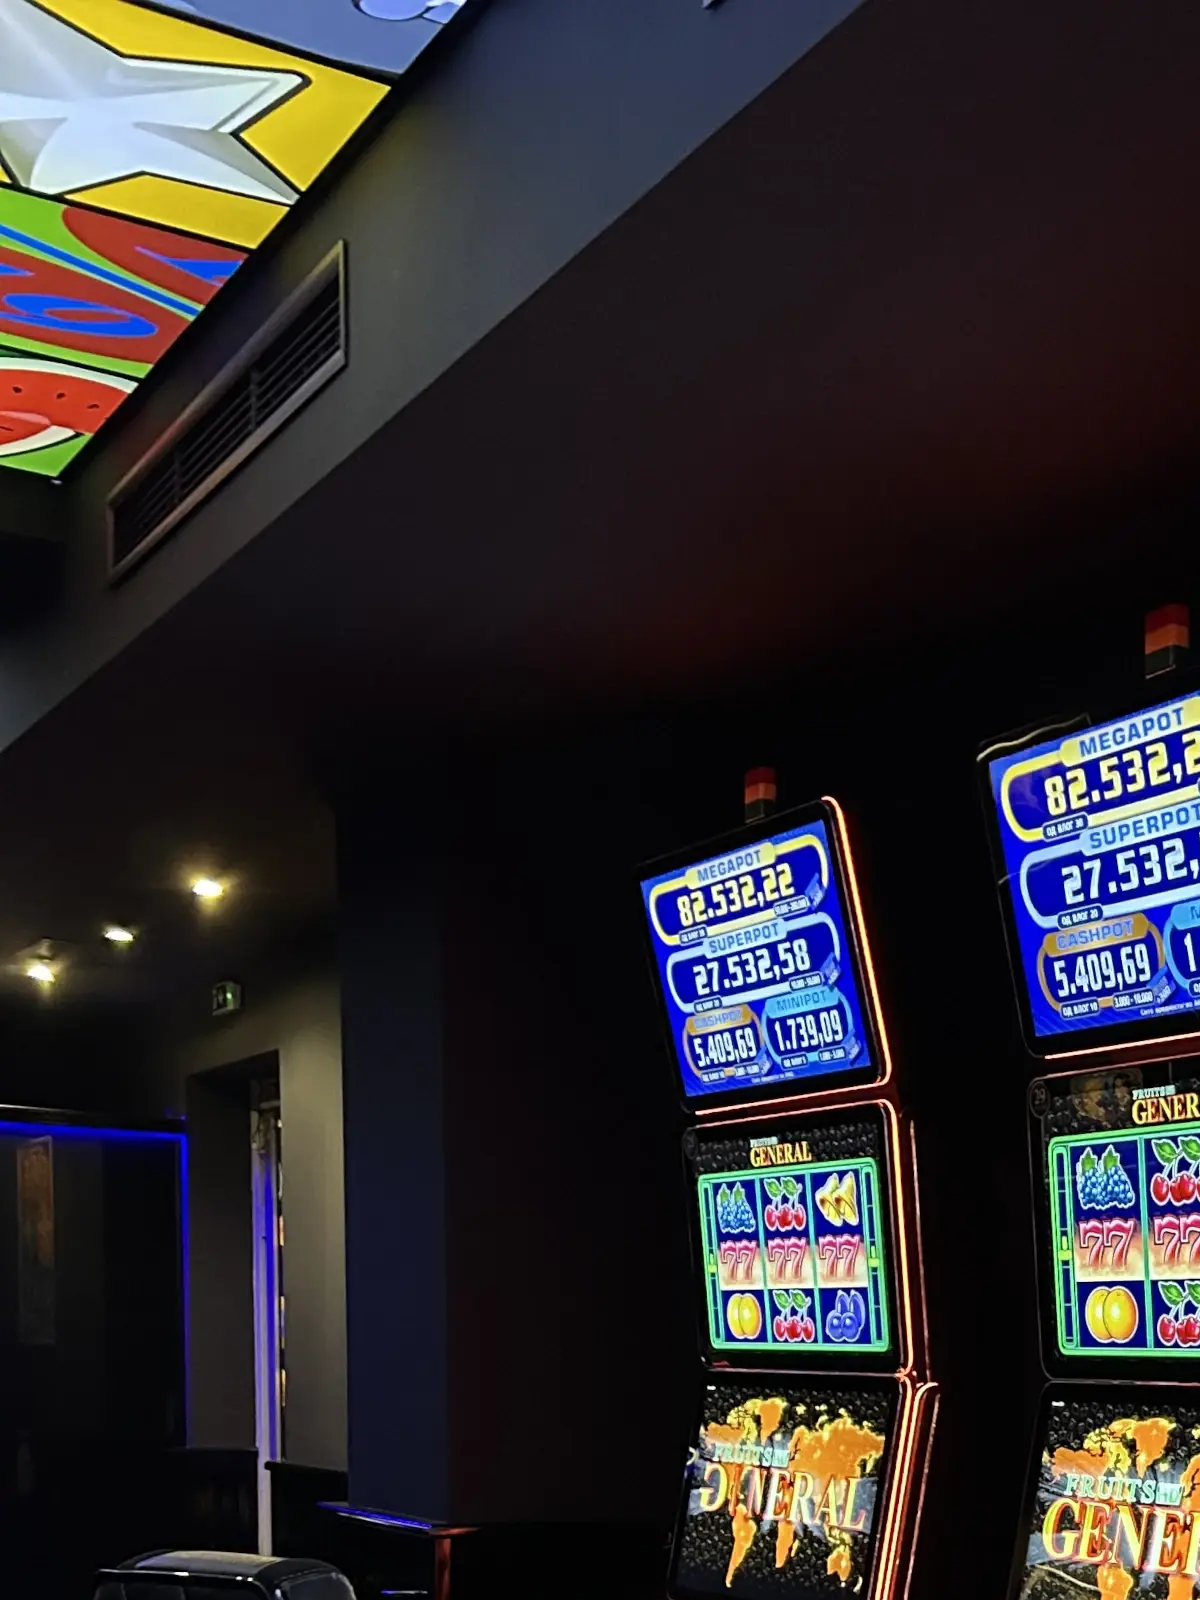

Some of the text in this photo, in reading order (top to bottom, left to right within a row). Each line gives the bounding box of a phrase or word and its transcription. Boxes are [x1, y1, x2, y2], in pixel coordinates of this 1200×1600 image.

[1079, 707, 1184, 758] MEGAPOT
[697, 850, 761, 882] MEGAPOT
[677, 862, 795, 927] 82.532,22
[709, 923, 779, 953] SUPERPOT
[1057, 918, 1133, 949] CASHPOT
[692, 938, 811, 996] 27.532,58
[1053, 943, 1151, 997] 5.409,69
[776, 990, 827, 1011] MINIPOT
[693, 1027, 757, 1067] 5.409,69
[774, 1009, 844, 1051] 1.739,09
[750, 1141, 812, 1167] GENERAL
[1064, 1474, 1156, 1504] FRUITS
